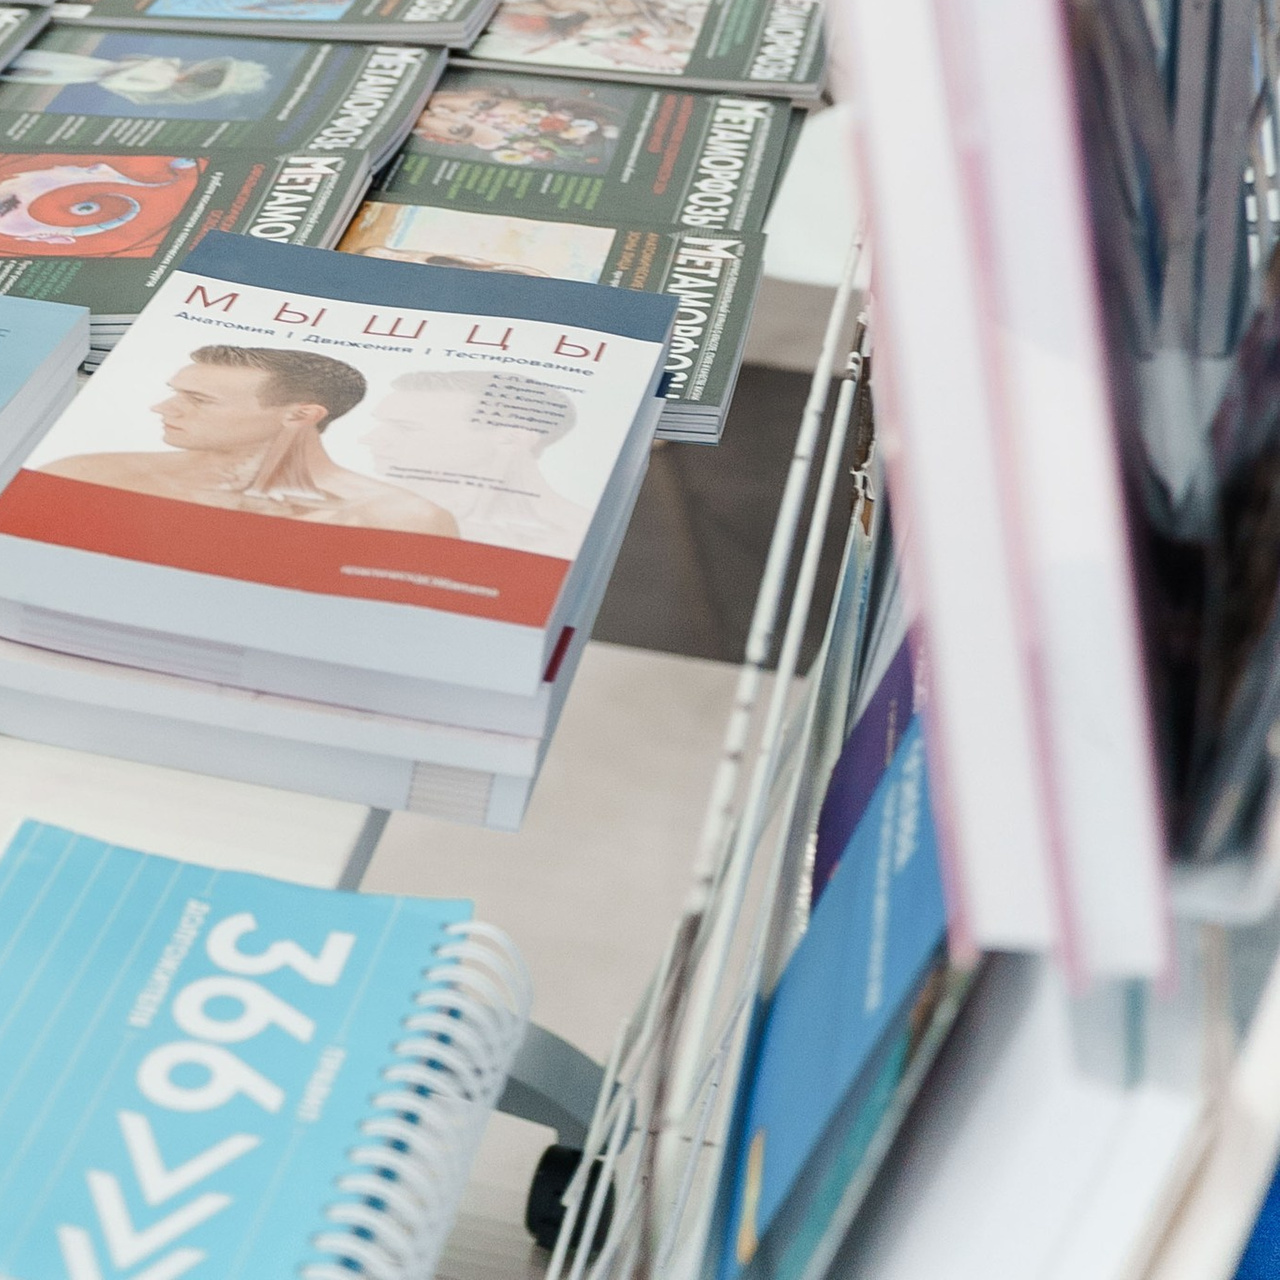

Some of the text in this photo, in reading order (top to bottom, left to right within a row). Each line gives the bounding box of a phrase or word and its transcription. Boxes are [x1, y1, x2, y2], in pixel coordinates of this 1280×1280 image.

[249, 154, 340, 246] МЕТАМО
[174, 310, 595, 377] Анатомия Движения Тестирование
[137, 911, 357, 1116] 366
